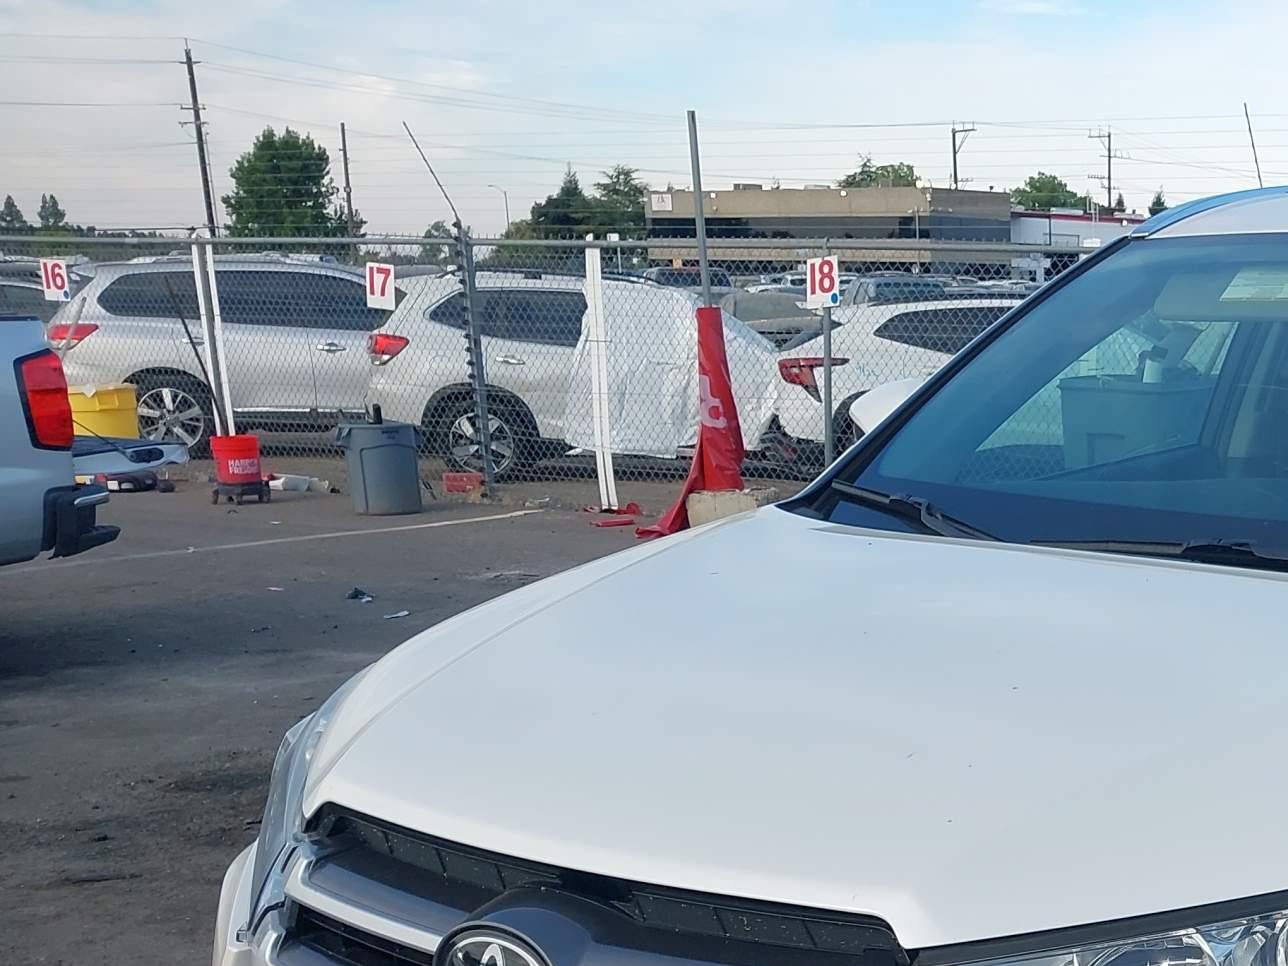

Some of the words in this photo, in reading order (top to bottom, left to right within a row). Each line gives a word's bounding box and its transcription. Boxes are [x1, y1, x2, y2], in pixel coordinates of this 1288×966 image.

[43, 262, 66, 290] 16
[369, 266, 391, 297] 17
[810, 260, 835, 295] 18
